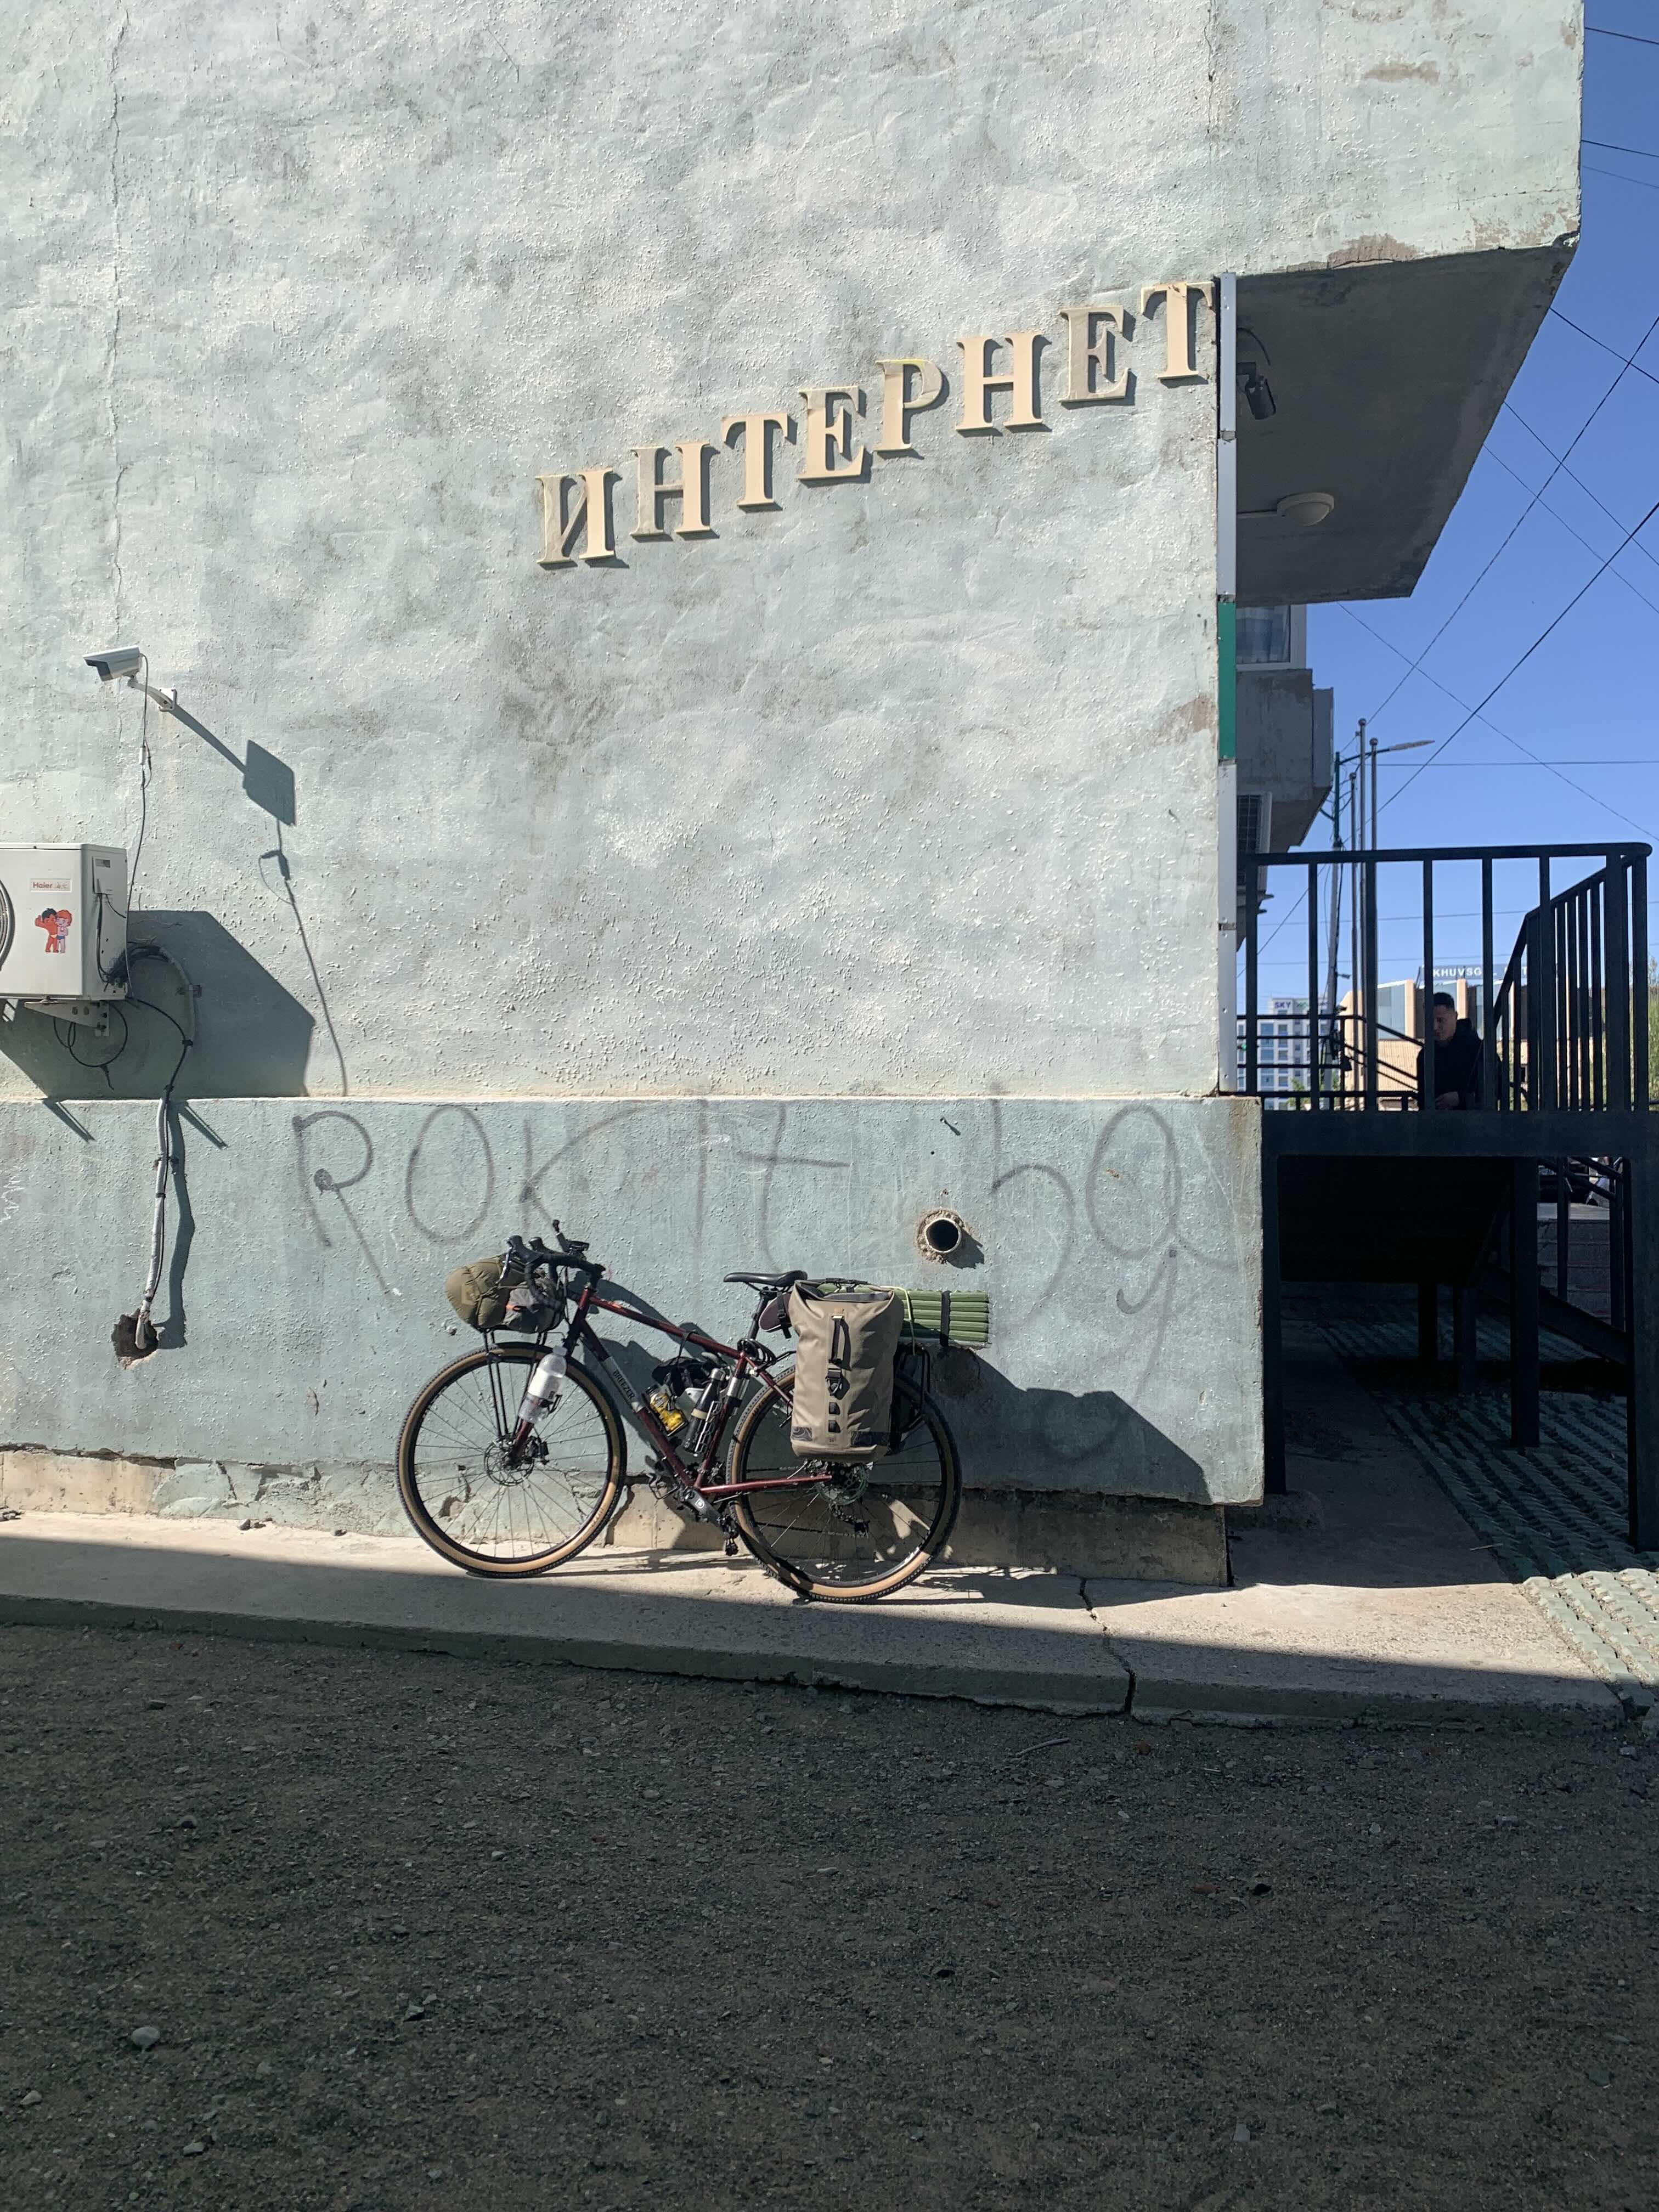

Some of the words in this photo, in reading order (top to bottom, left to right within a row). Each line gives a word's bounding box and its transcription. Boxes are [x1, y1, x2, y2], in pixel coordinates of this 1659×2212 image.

[535, 281, 1214, 566] ИНТЕРНЕТ
[1432, 967, 1497, 977] KHUVSG
[613, 1369, 635, 1400] BREEZER
